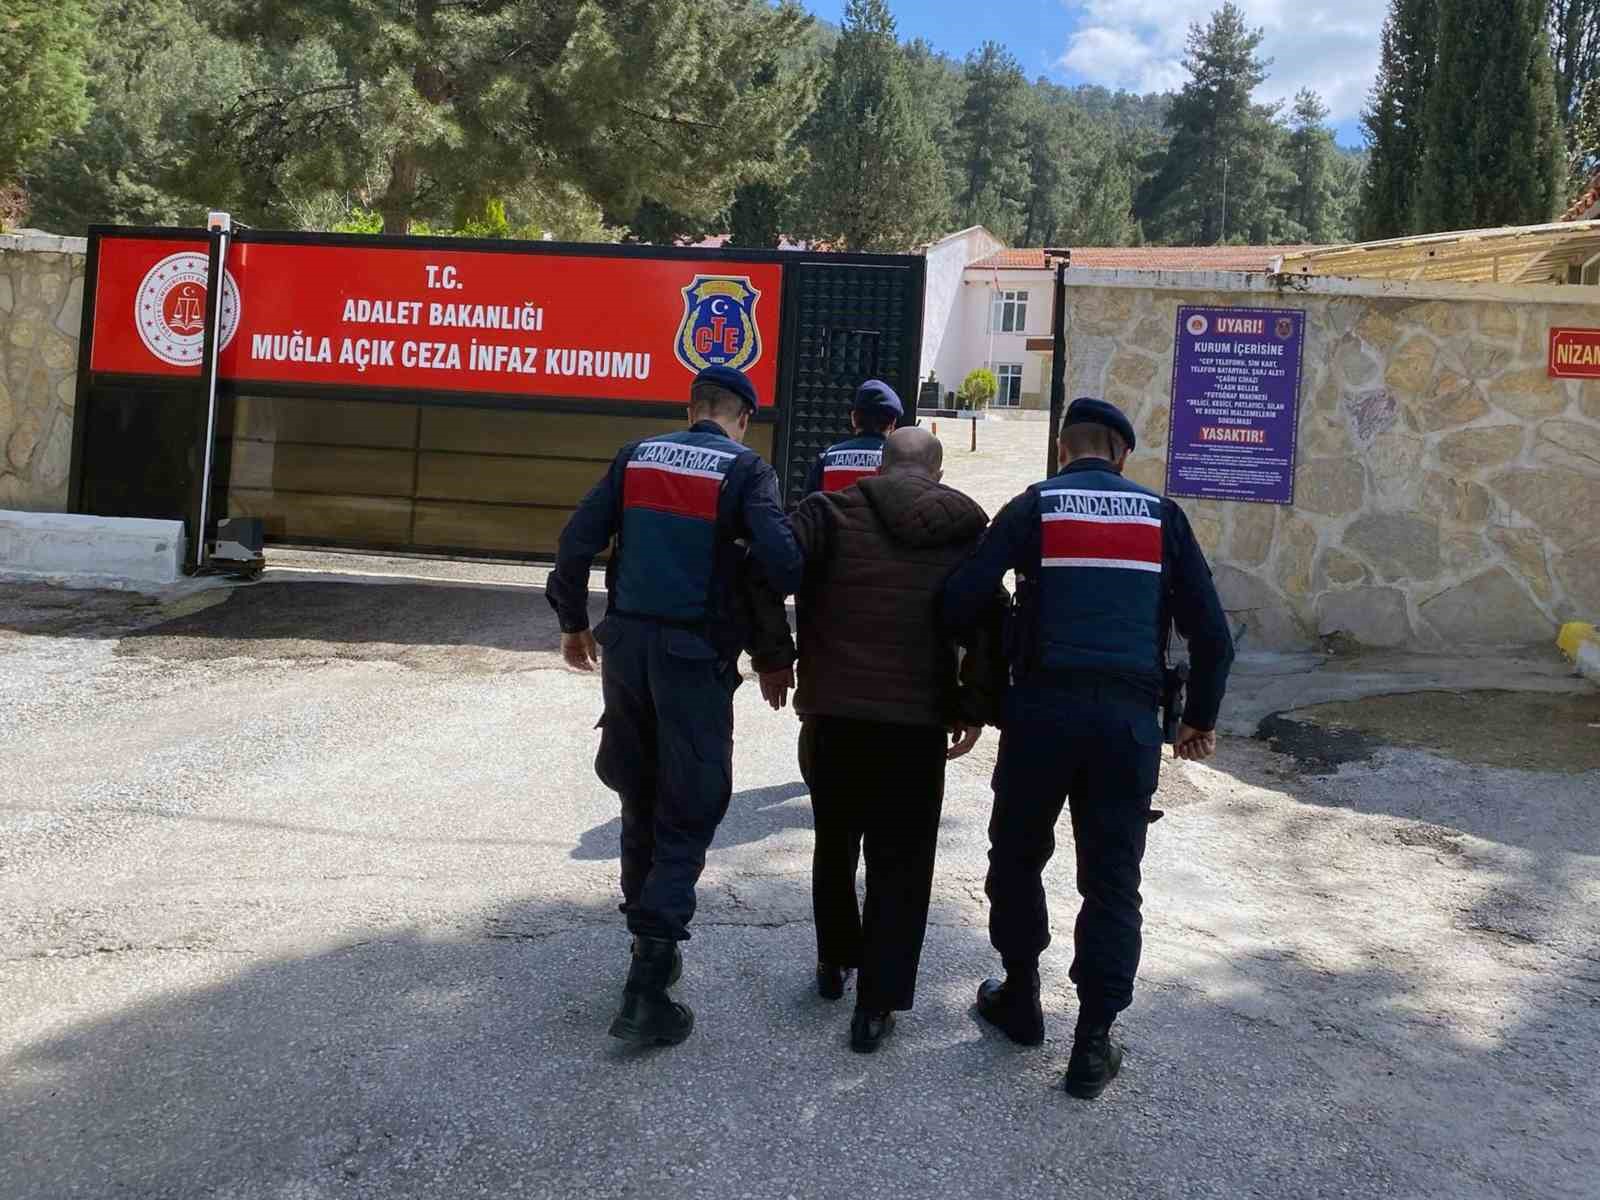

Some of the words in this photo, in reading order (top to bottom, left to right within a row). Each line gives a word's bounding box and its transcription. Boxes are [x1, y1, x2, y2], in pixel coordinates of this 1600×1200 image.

[426, 265, 463, 290] T.C.
[343, 298, 424, 325] ADALET
[429, 301, 544, 332] BAKANLIĞI
[1217, 318, 1263, 334] UYARI!
[695, 316, 739, 353] CTE
[251, 330, 332, 364] MUĞLA
[339, 338, 396, 373] AÇIK
[402, 341, 462, 370] CEZA
[468, 337, 538, 374] İNFAZ
[544, 349, 651, 381] KURUMU
[1194, 342, 1231, 353] KURUM
[1233, 341, 1284, 356] İÇERİSİNE
[1201, 427, 1265, 443] YASAKTIR!
[637, 445, 722, 471] JANDARMA
[832, 454, 882, 467] JANDARM
[1054, 494, 1151, 517] JANDARMA
